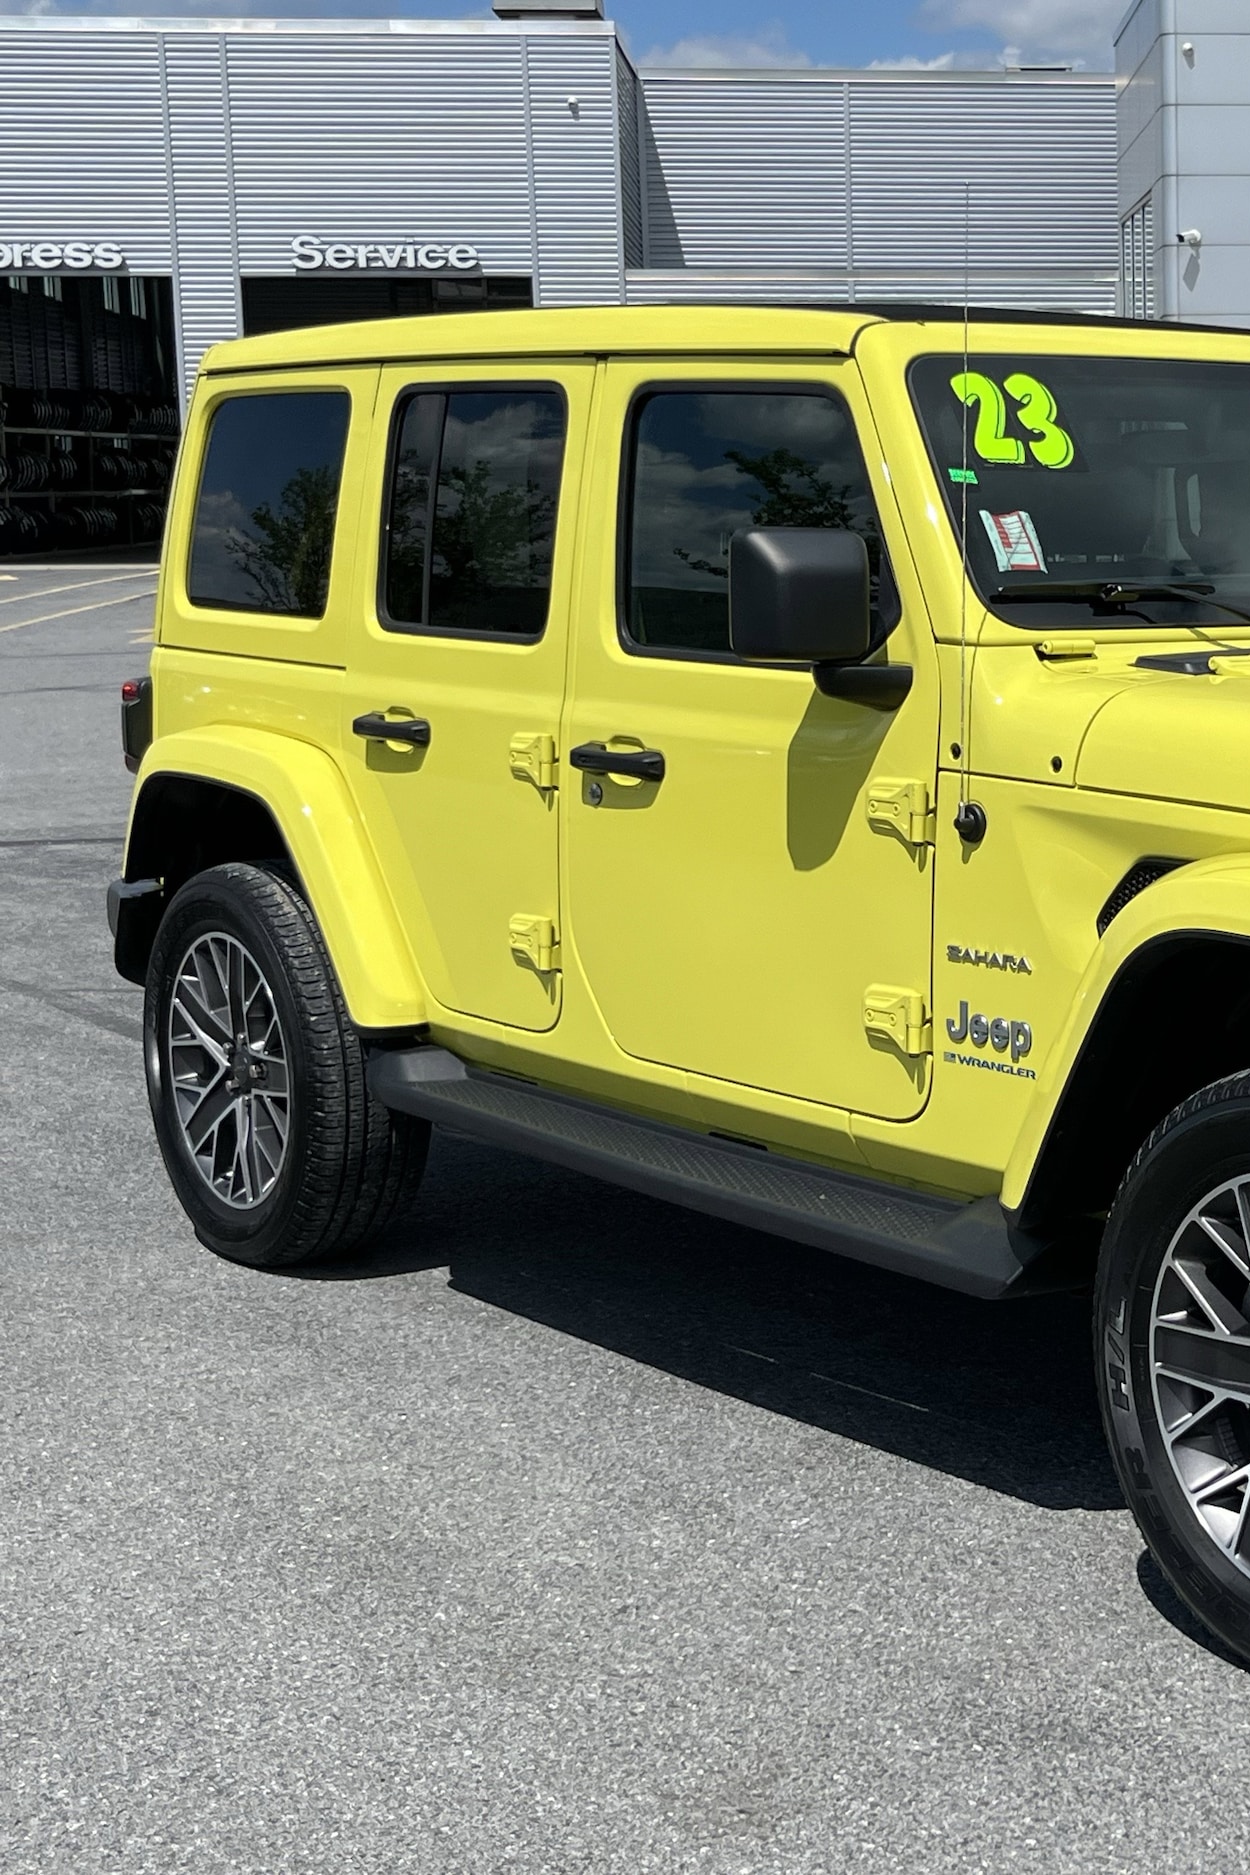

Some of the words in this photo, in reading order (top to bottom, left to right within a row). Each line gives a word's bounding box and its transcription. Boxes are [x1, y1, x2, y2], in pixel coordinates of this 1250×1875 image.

[291, 235, 478, 269] Service
[950, 371, 1075, 469] 23
[947, 945, 1032, 975] SAHARA
[946, 1000, 1032, 1063] Jeep
[957, 1054, 1036, 1080] WRANGLER
[1108, 1298, 1130, 1411] H/L
